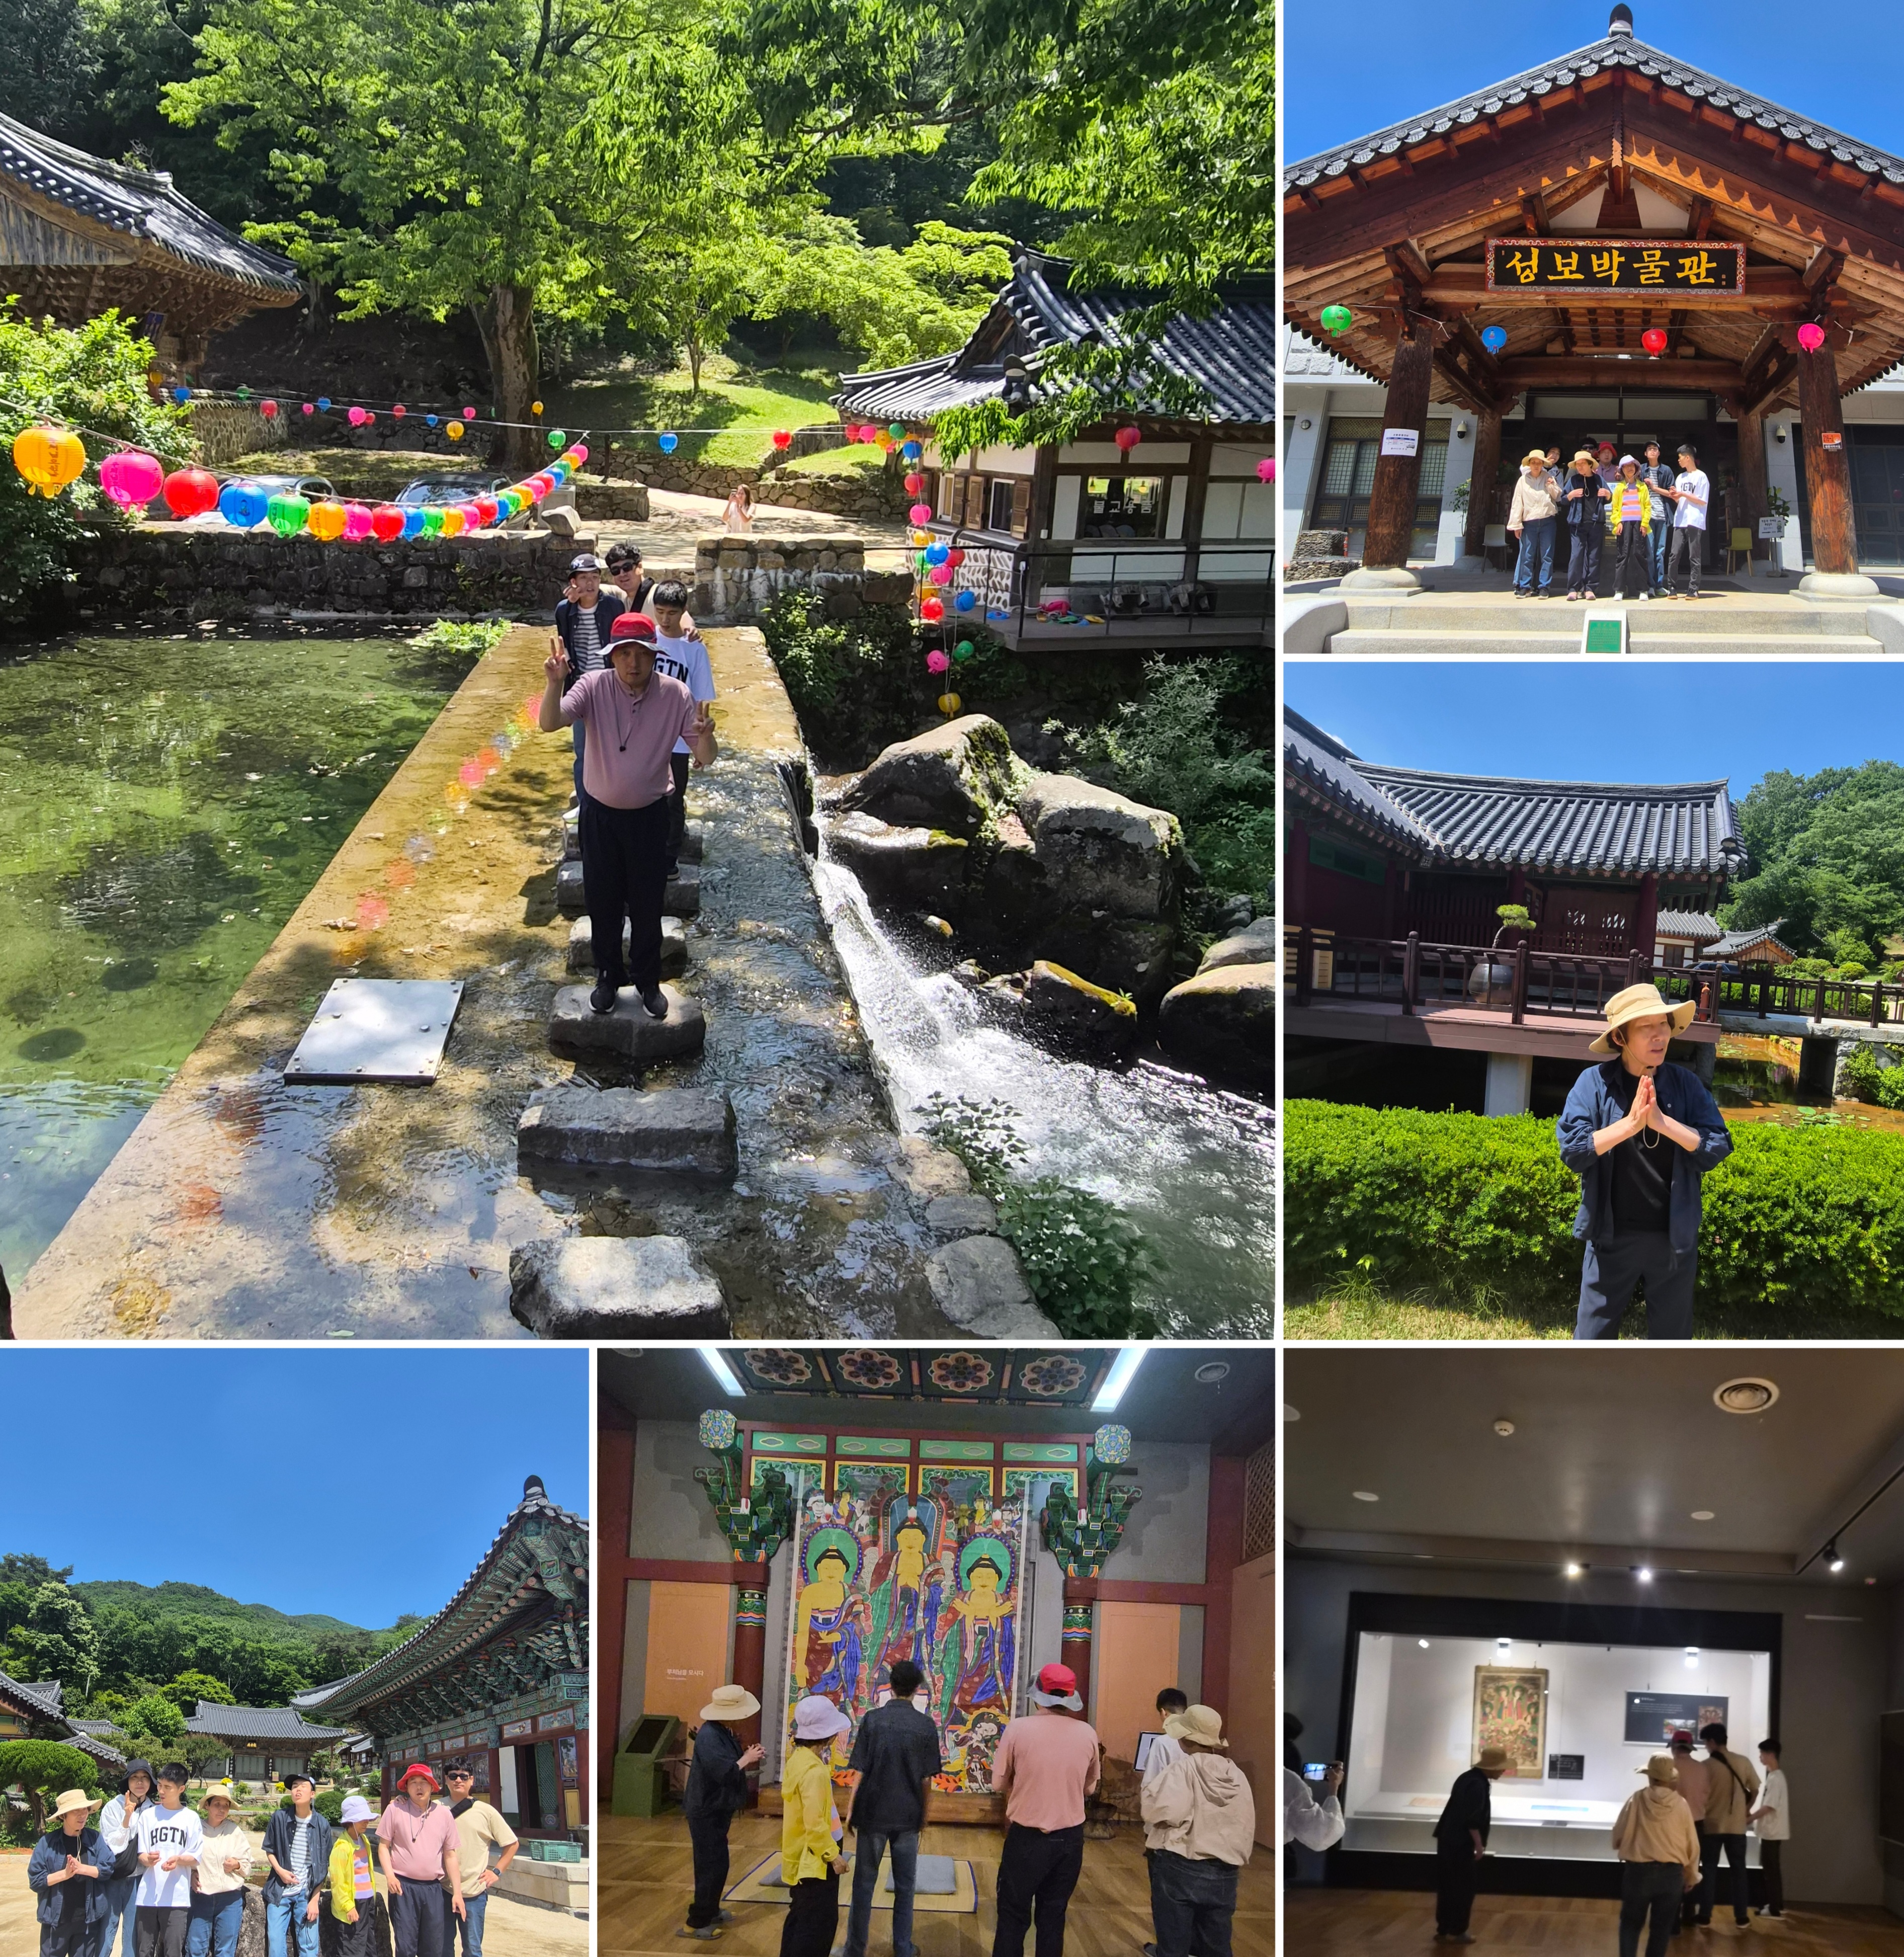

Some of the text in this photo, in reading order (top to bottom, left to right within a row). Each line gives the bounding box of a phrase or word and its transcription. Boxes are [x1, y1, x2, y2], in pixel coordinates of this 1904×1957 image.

[1506, 247, 1717, 286] 성보박물관
[1681, 482, 1696, 494] GTN
[1094, 500, 1153, 514] 불교용품
[150, 1827, 187, 1848] HGTN
